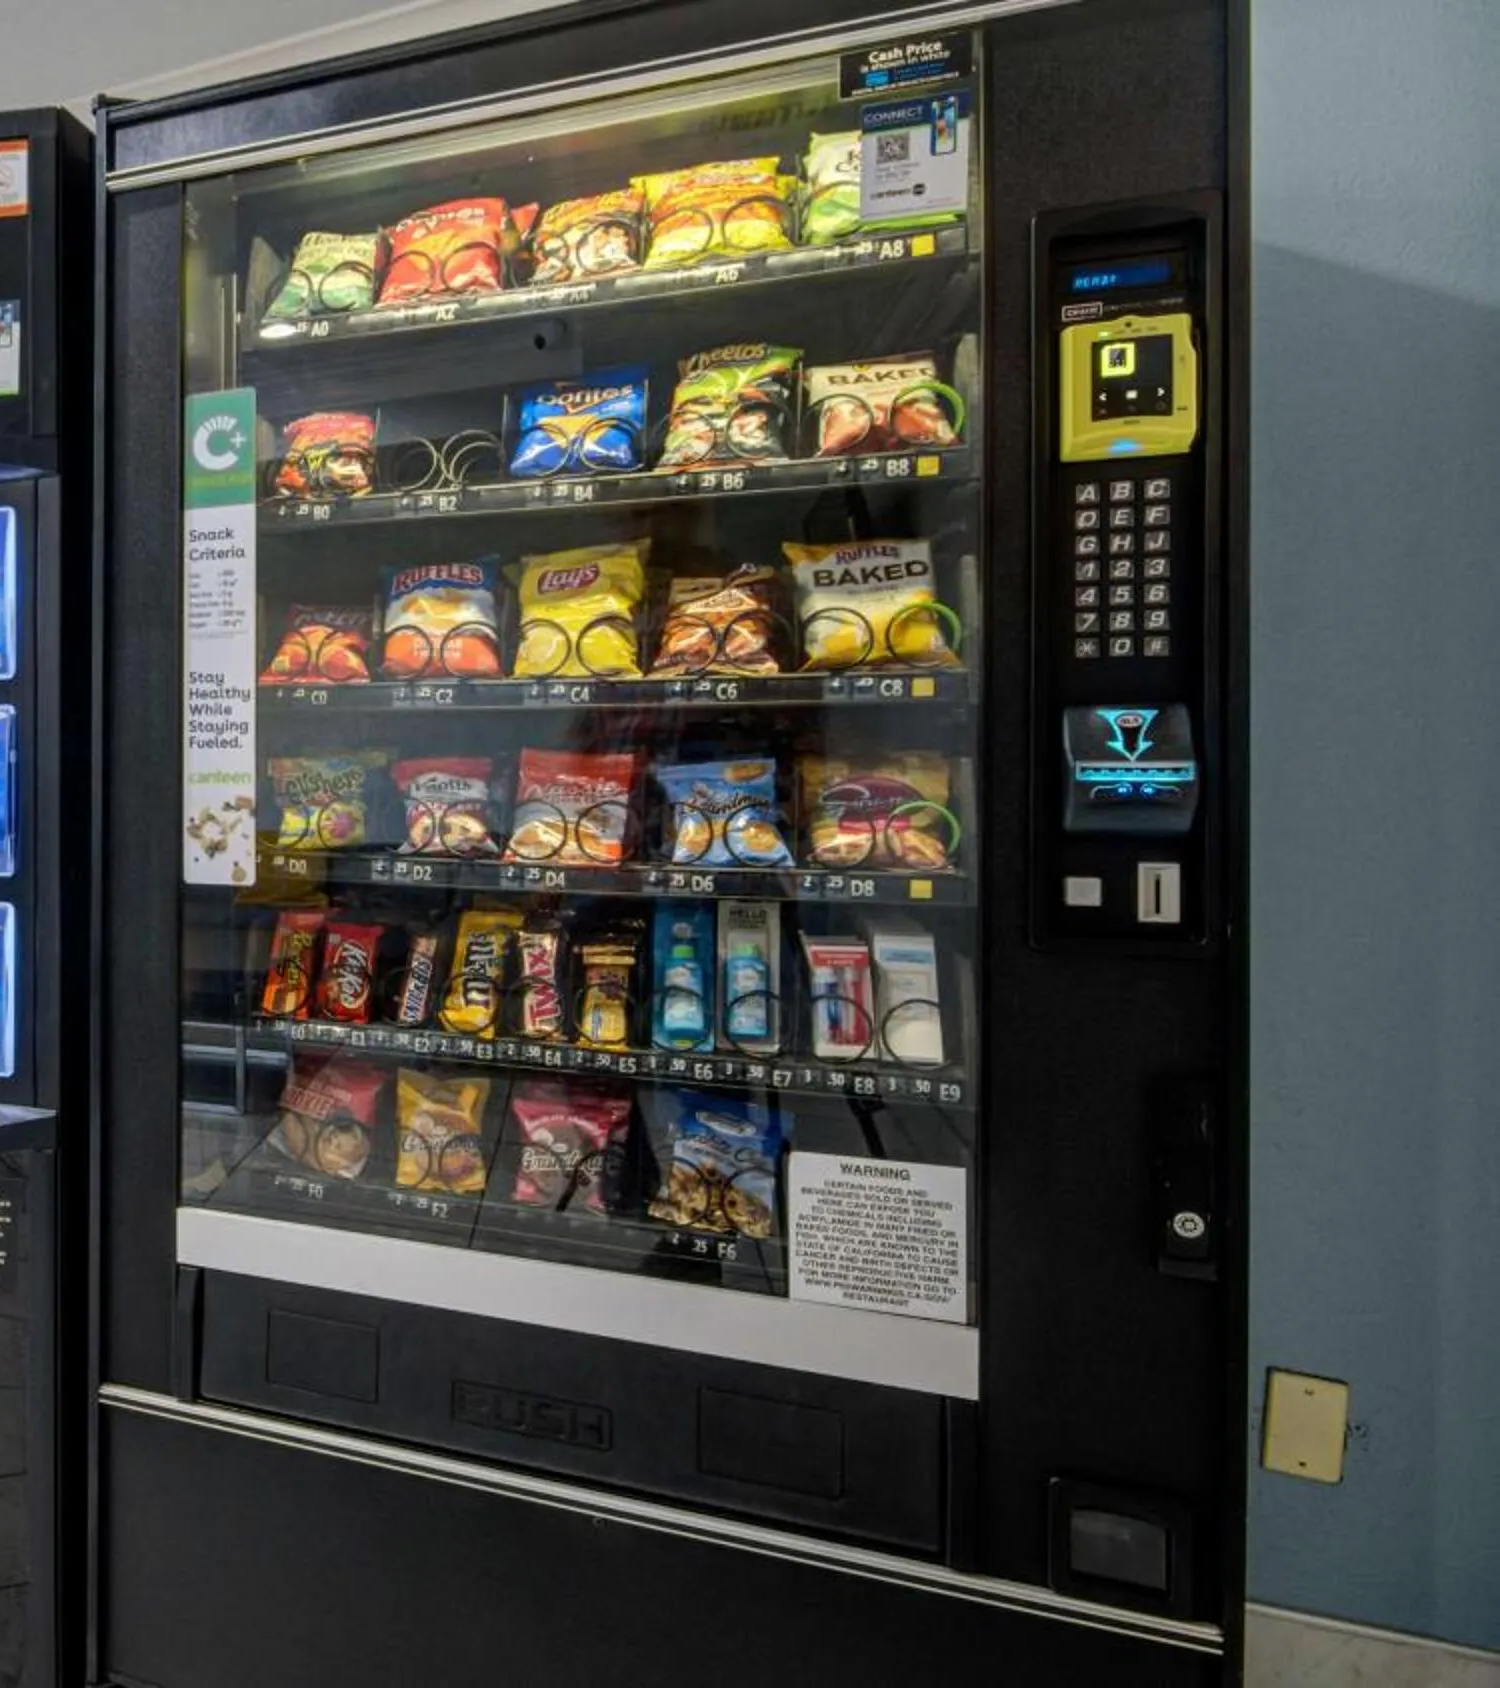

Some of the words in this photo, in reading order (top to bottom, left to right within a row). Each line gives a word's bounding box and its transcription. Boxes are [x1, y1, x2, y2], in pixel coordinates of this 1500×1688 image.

[868, 48, 903, 64] Cash
[906, 41, 942, 56] Price
[863, 105, 924, 124] CONNECT
[879, 240, 905, 260] A8
[886, 457, 910, 477] B8
[722, 472, 745, 490] B6
[1079, 484, 1096, 502] A
[1114, 481, 1131, 499] B
[1149, 480, 1166, 497] C
[1114, 509, 1131, 526] E
[1149, 507, 1165, 523] F
[189, 526, 234, 543] Snack
[1079, 537, 1097, 554] G
[1112, 535, 1131, 551] H
[1149, 534, 1165, 548] J
[189, 547, 246, 562] Criteria
[812, 559, 930, 588] BAKED
[1150, 559, 1165, 575] 3
[539, 563, 599, 592] Lay's
[1081, 588, 1095, 603] 4
[1115, 586, 1130, 601] 5
[1150, 585, 1165, 601] 6
[1082, 613, 1096, 628] 7
[1115, 612, 1131, 627] 8
[1150, 611, 1165, 627] 9
[1115, 639, 1131, 653] 0
[188, 671, 225, 686] Stay
[188, 687, 251, 703] Healthy
[435, 688, 453, 704] C2
[570, 686, 589, 702] C4
[716, 683, 738, 701] C6
[880, 678, 903, 697] C8
[311, 690, 328, 705] C0
[188, 702, 233, 716] While
[188, 719, 250, 736] Staying
[188, 735, 244, 749] Fueled.
[188, 770, 252, 786] canteen
[413, 865, 432, 881] D2
[546, 871, 566, 887] D4
[691, 875, 715, 893] D6
[851, 879, 876, 897] D8
[529, 947, 560, 1020] TWIX
[477, 1044, 493, 1059] E3
[545, 1051, 561, 1066] E4
[618, 1057, 637, 1073] E5
[694, 1063, 713, 1081] E6
[773, 1070, 792, 1087] E7
[854, 1077, 875, 1095] E8
[940, 1084, 961, 1101] E9
[839, 1163, 911, 1181] WARNING
[431, 1202, 448, 1219] F2
[718, 1243, 737, 1260] F6
[456, 1384, 604, 1446] PUSH
